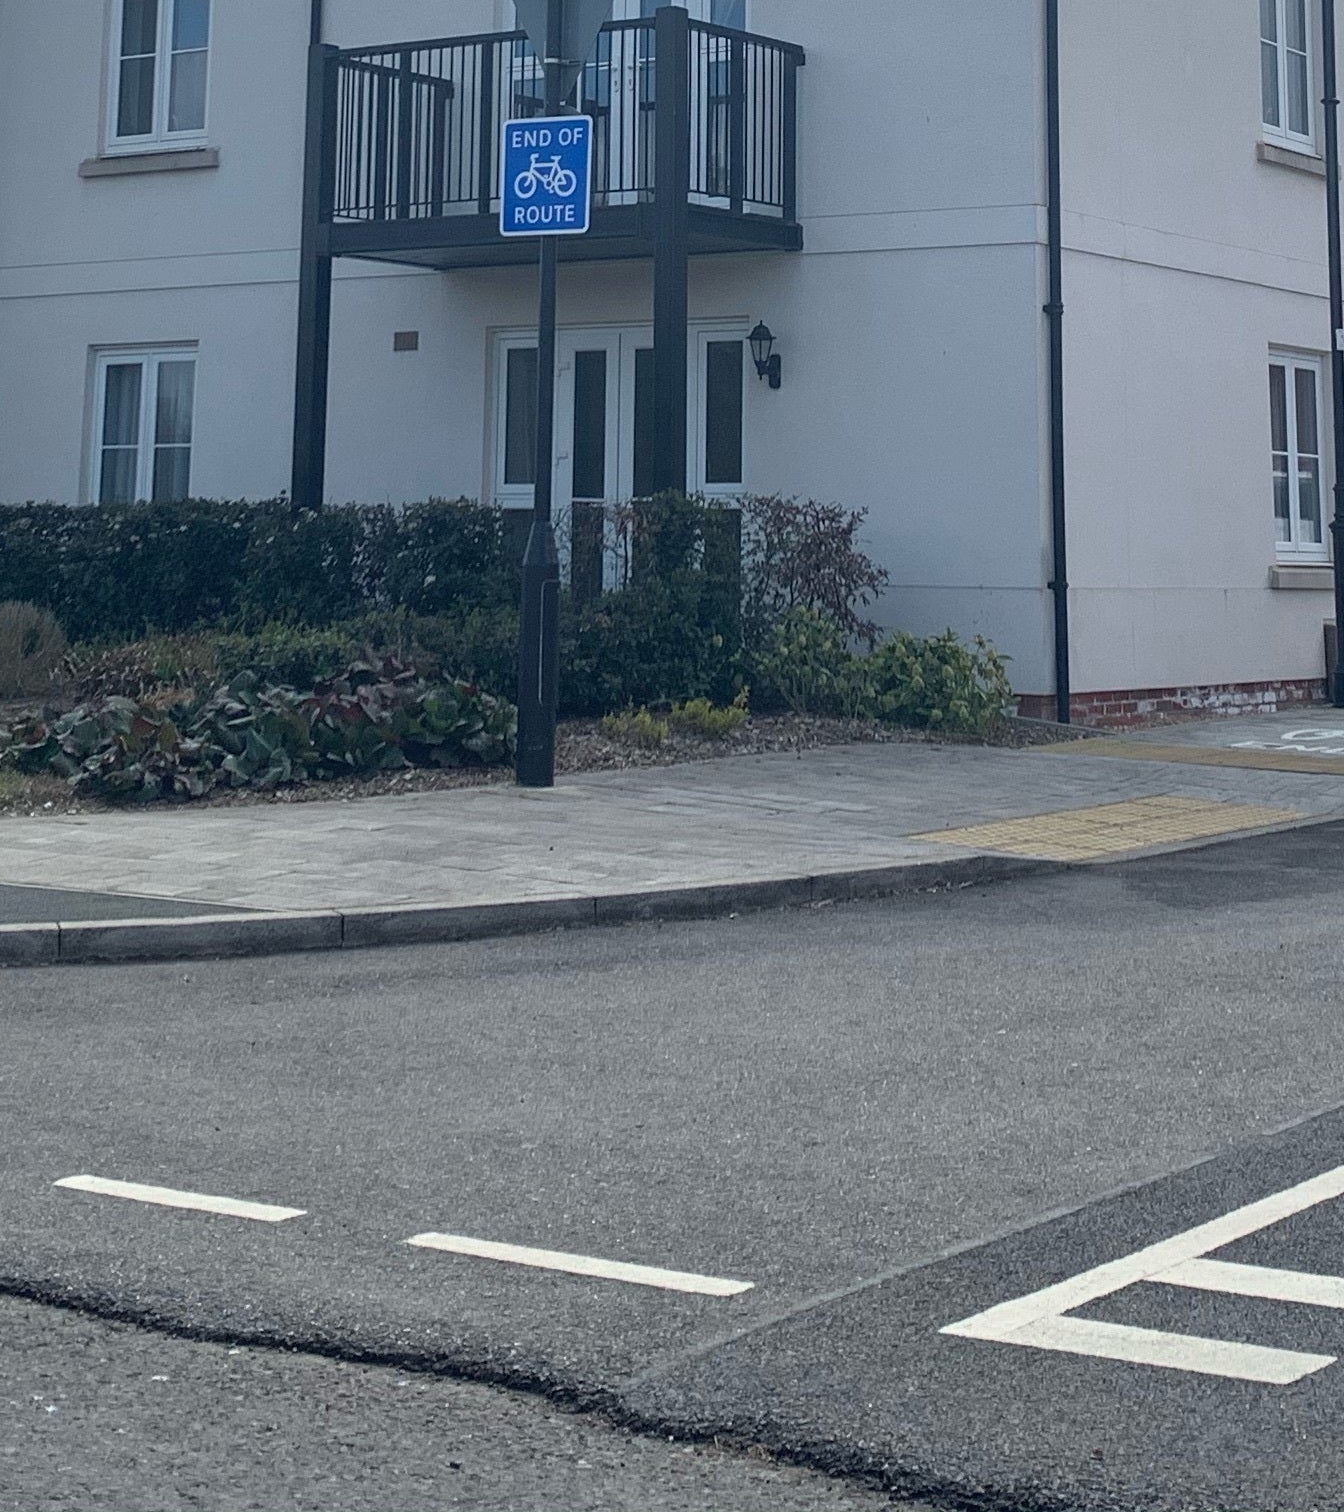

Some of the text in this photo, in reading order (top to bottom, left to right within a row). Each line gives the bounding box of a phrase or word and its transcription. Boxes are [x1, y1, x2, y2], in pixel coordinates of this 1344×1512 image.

[512, 127, 584, 148] END OF
[514, 204, 575, 224] ROUTE
